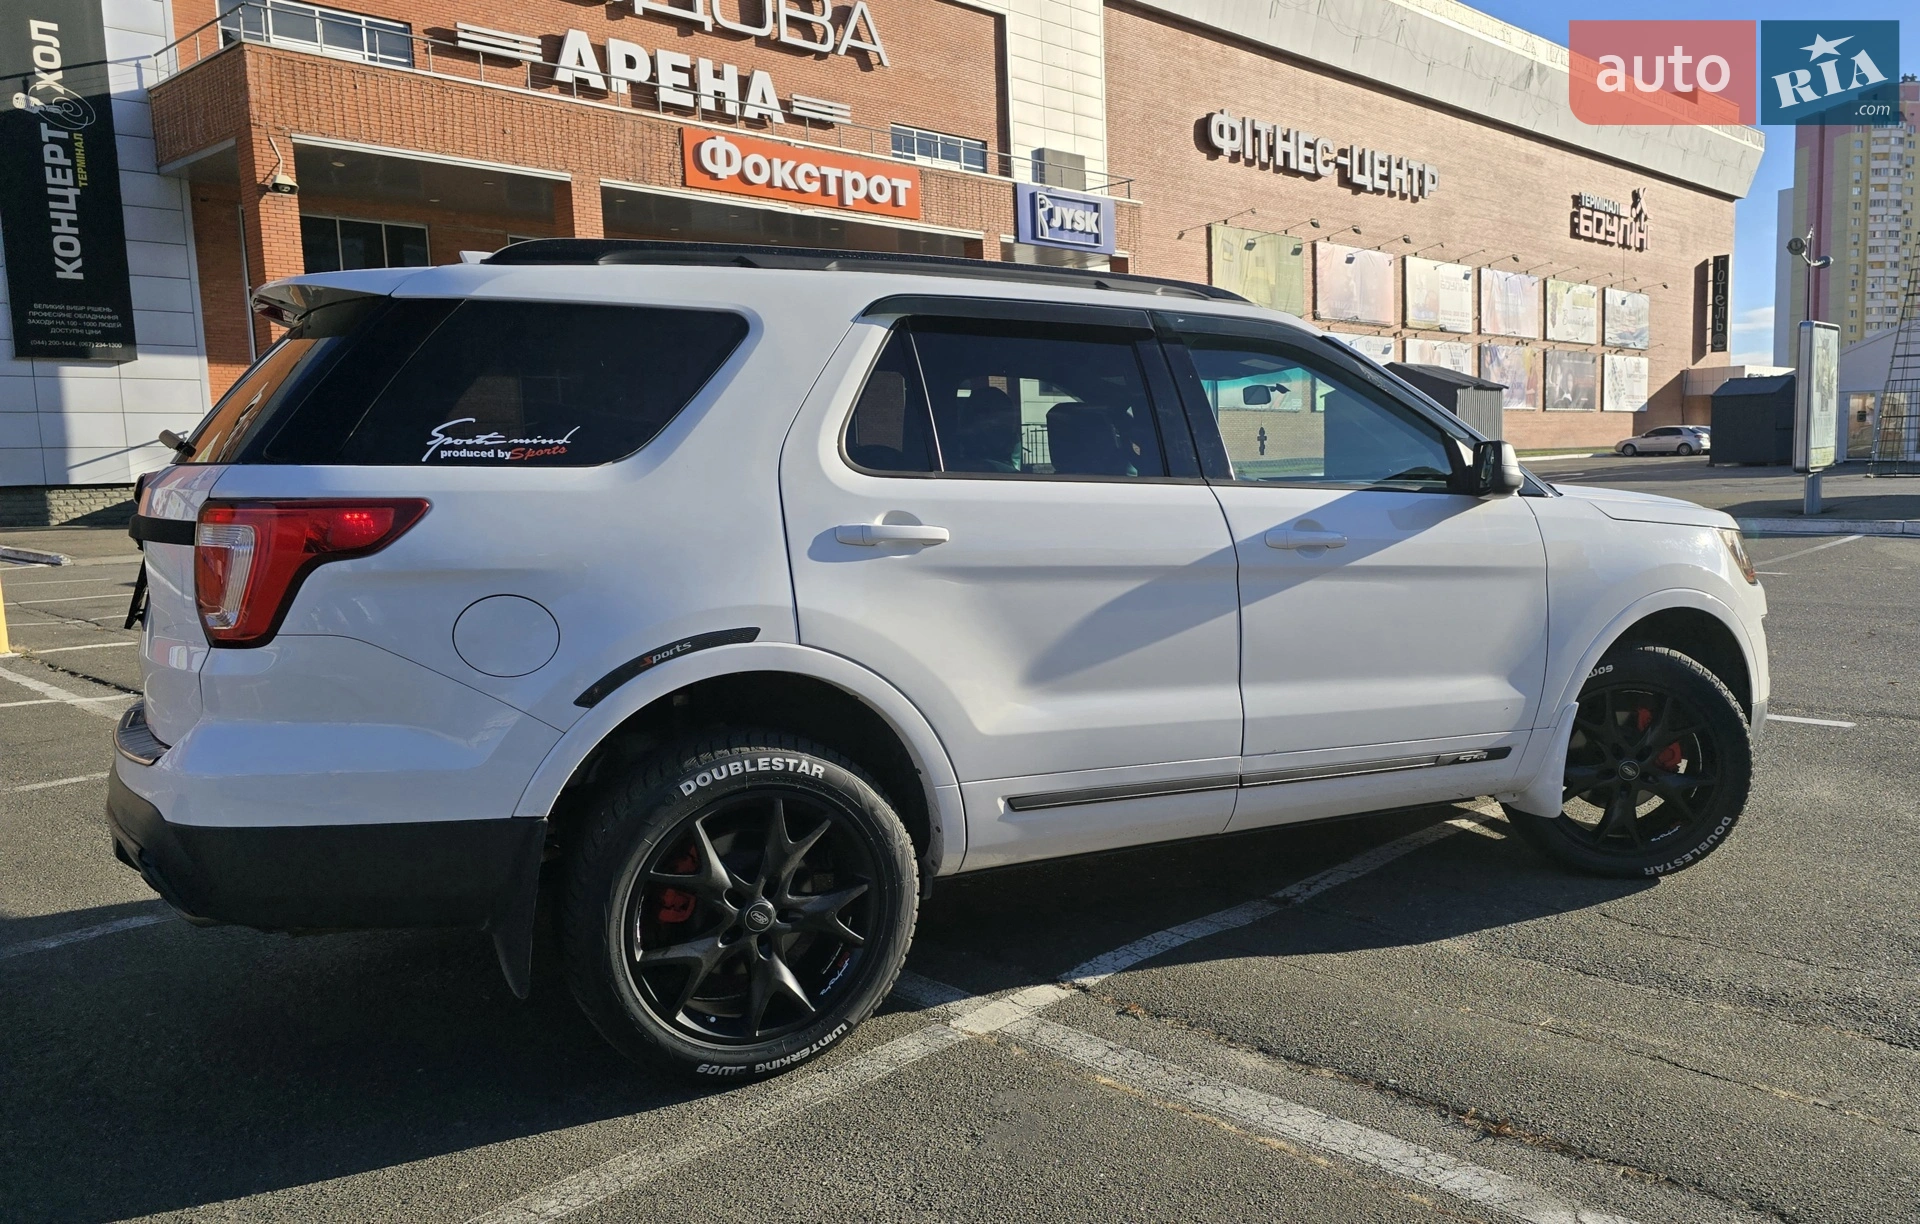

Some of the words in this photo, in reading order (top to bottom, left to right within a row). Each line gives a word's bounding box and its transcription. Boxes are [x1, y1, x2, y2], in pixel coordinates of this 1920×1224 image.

[29, 19, 66, 94] ХОЛ
[554, 29, 785, 124] АРЕНА
[77, 133, 89, 188] ТЕРМІНАЛ
[700, 136, 911, 207] Фокстрот
[1208, 109, 1440, 199] ФІТНЕС-ЦЕНТР
[40, 122, 85, 280] КОНЦЕРТ
[1050, 205, 1100, 234] JYSK
[1580, 192, 1619, 215] ТЕРМІНАЛ
[440, 448, 495, 459] produced
[497, 448, 512, 460] by
[509, 445, 568, 460] Sports
[678, 757, 826, 797] DOUBLESTAR
[1643, 815, 1733, 877] DOUBLESTAR
[754, 1021, 849, 1074] WINTERKING
